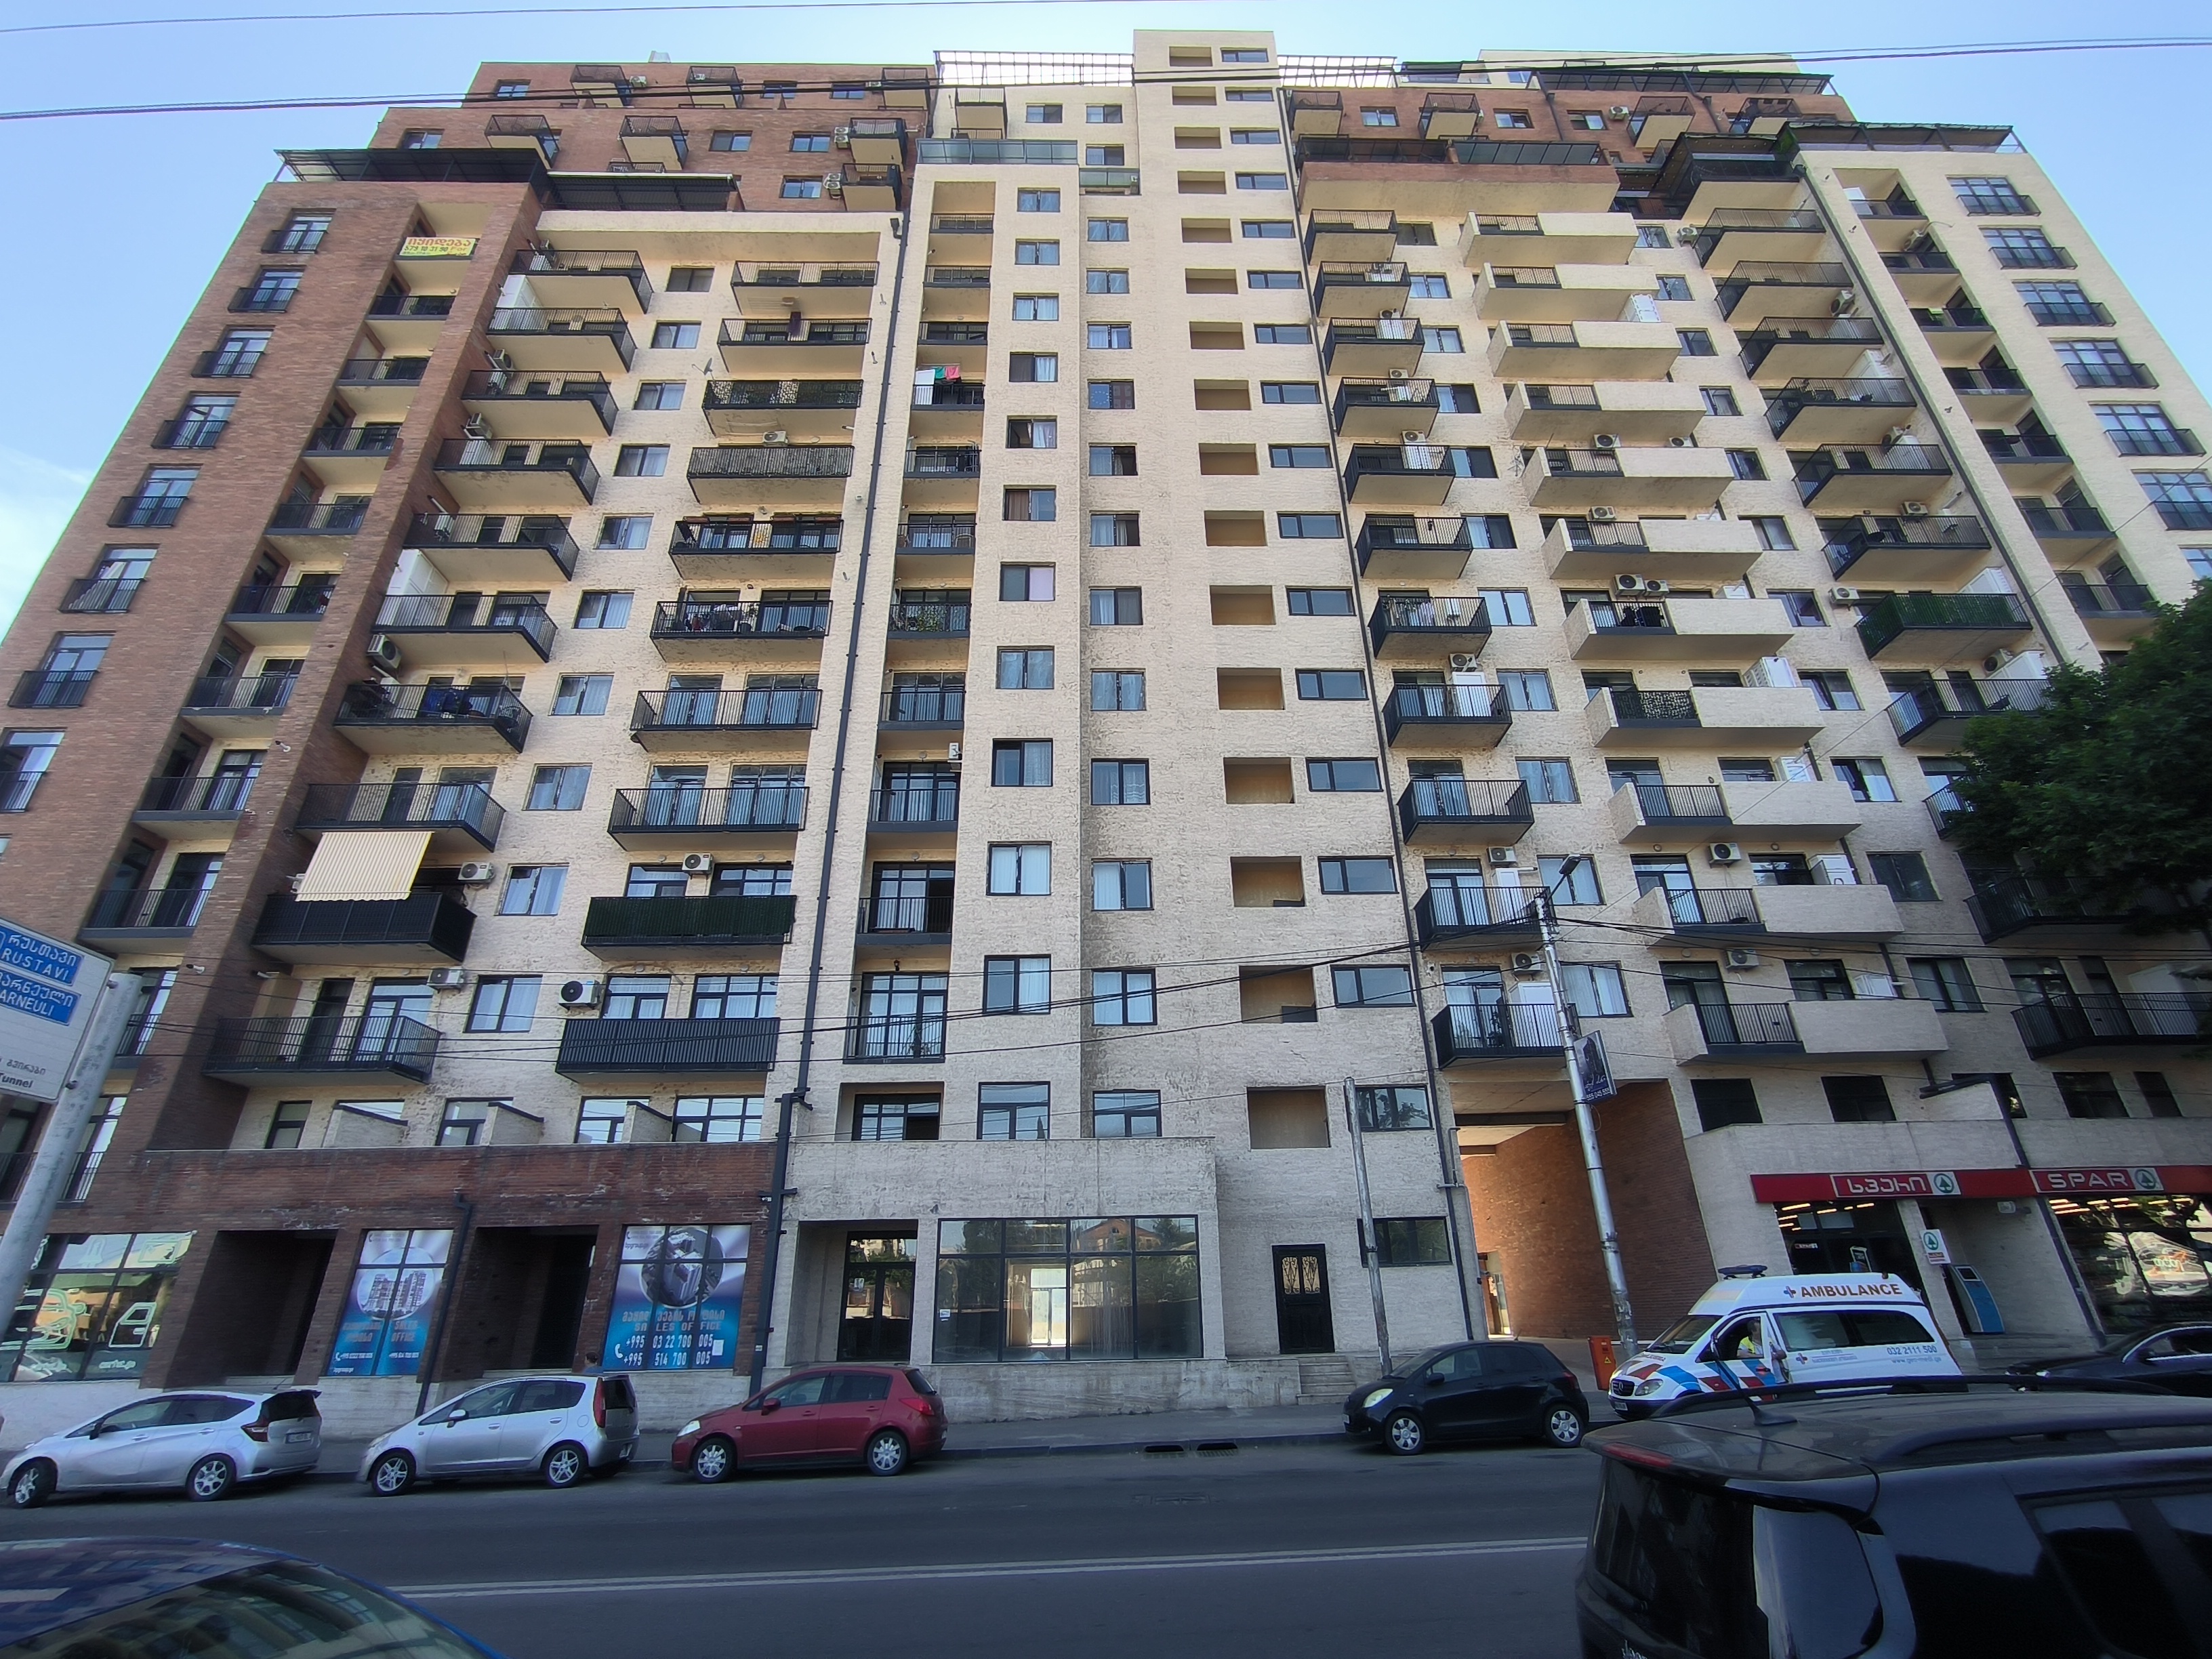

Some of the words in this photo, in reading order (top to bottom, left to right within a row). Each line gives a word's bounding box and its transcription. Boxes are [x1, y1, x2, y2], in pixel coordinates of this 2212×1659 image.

[408, 239, 471, 247] იყიდება
[8, 935, 77, 966] რუსთავი
[1, 947, 69, 981] RUSTAVI
[2047, 1172, 2129, 1188] SPAR
[1801, 1284, 1903, 1297] AMBULANCE
[626, 1335, 645, 1349] +995
[699, 1334, 714, 1347] 005
[623, 1353, 643, 1366] +995
[672, 1352, 687, 1366] 700
[696, 1351, 711, 1365] 005
